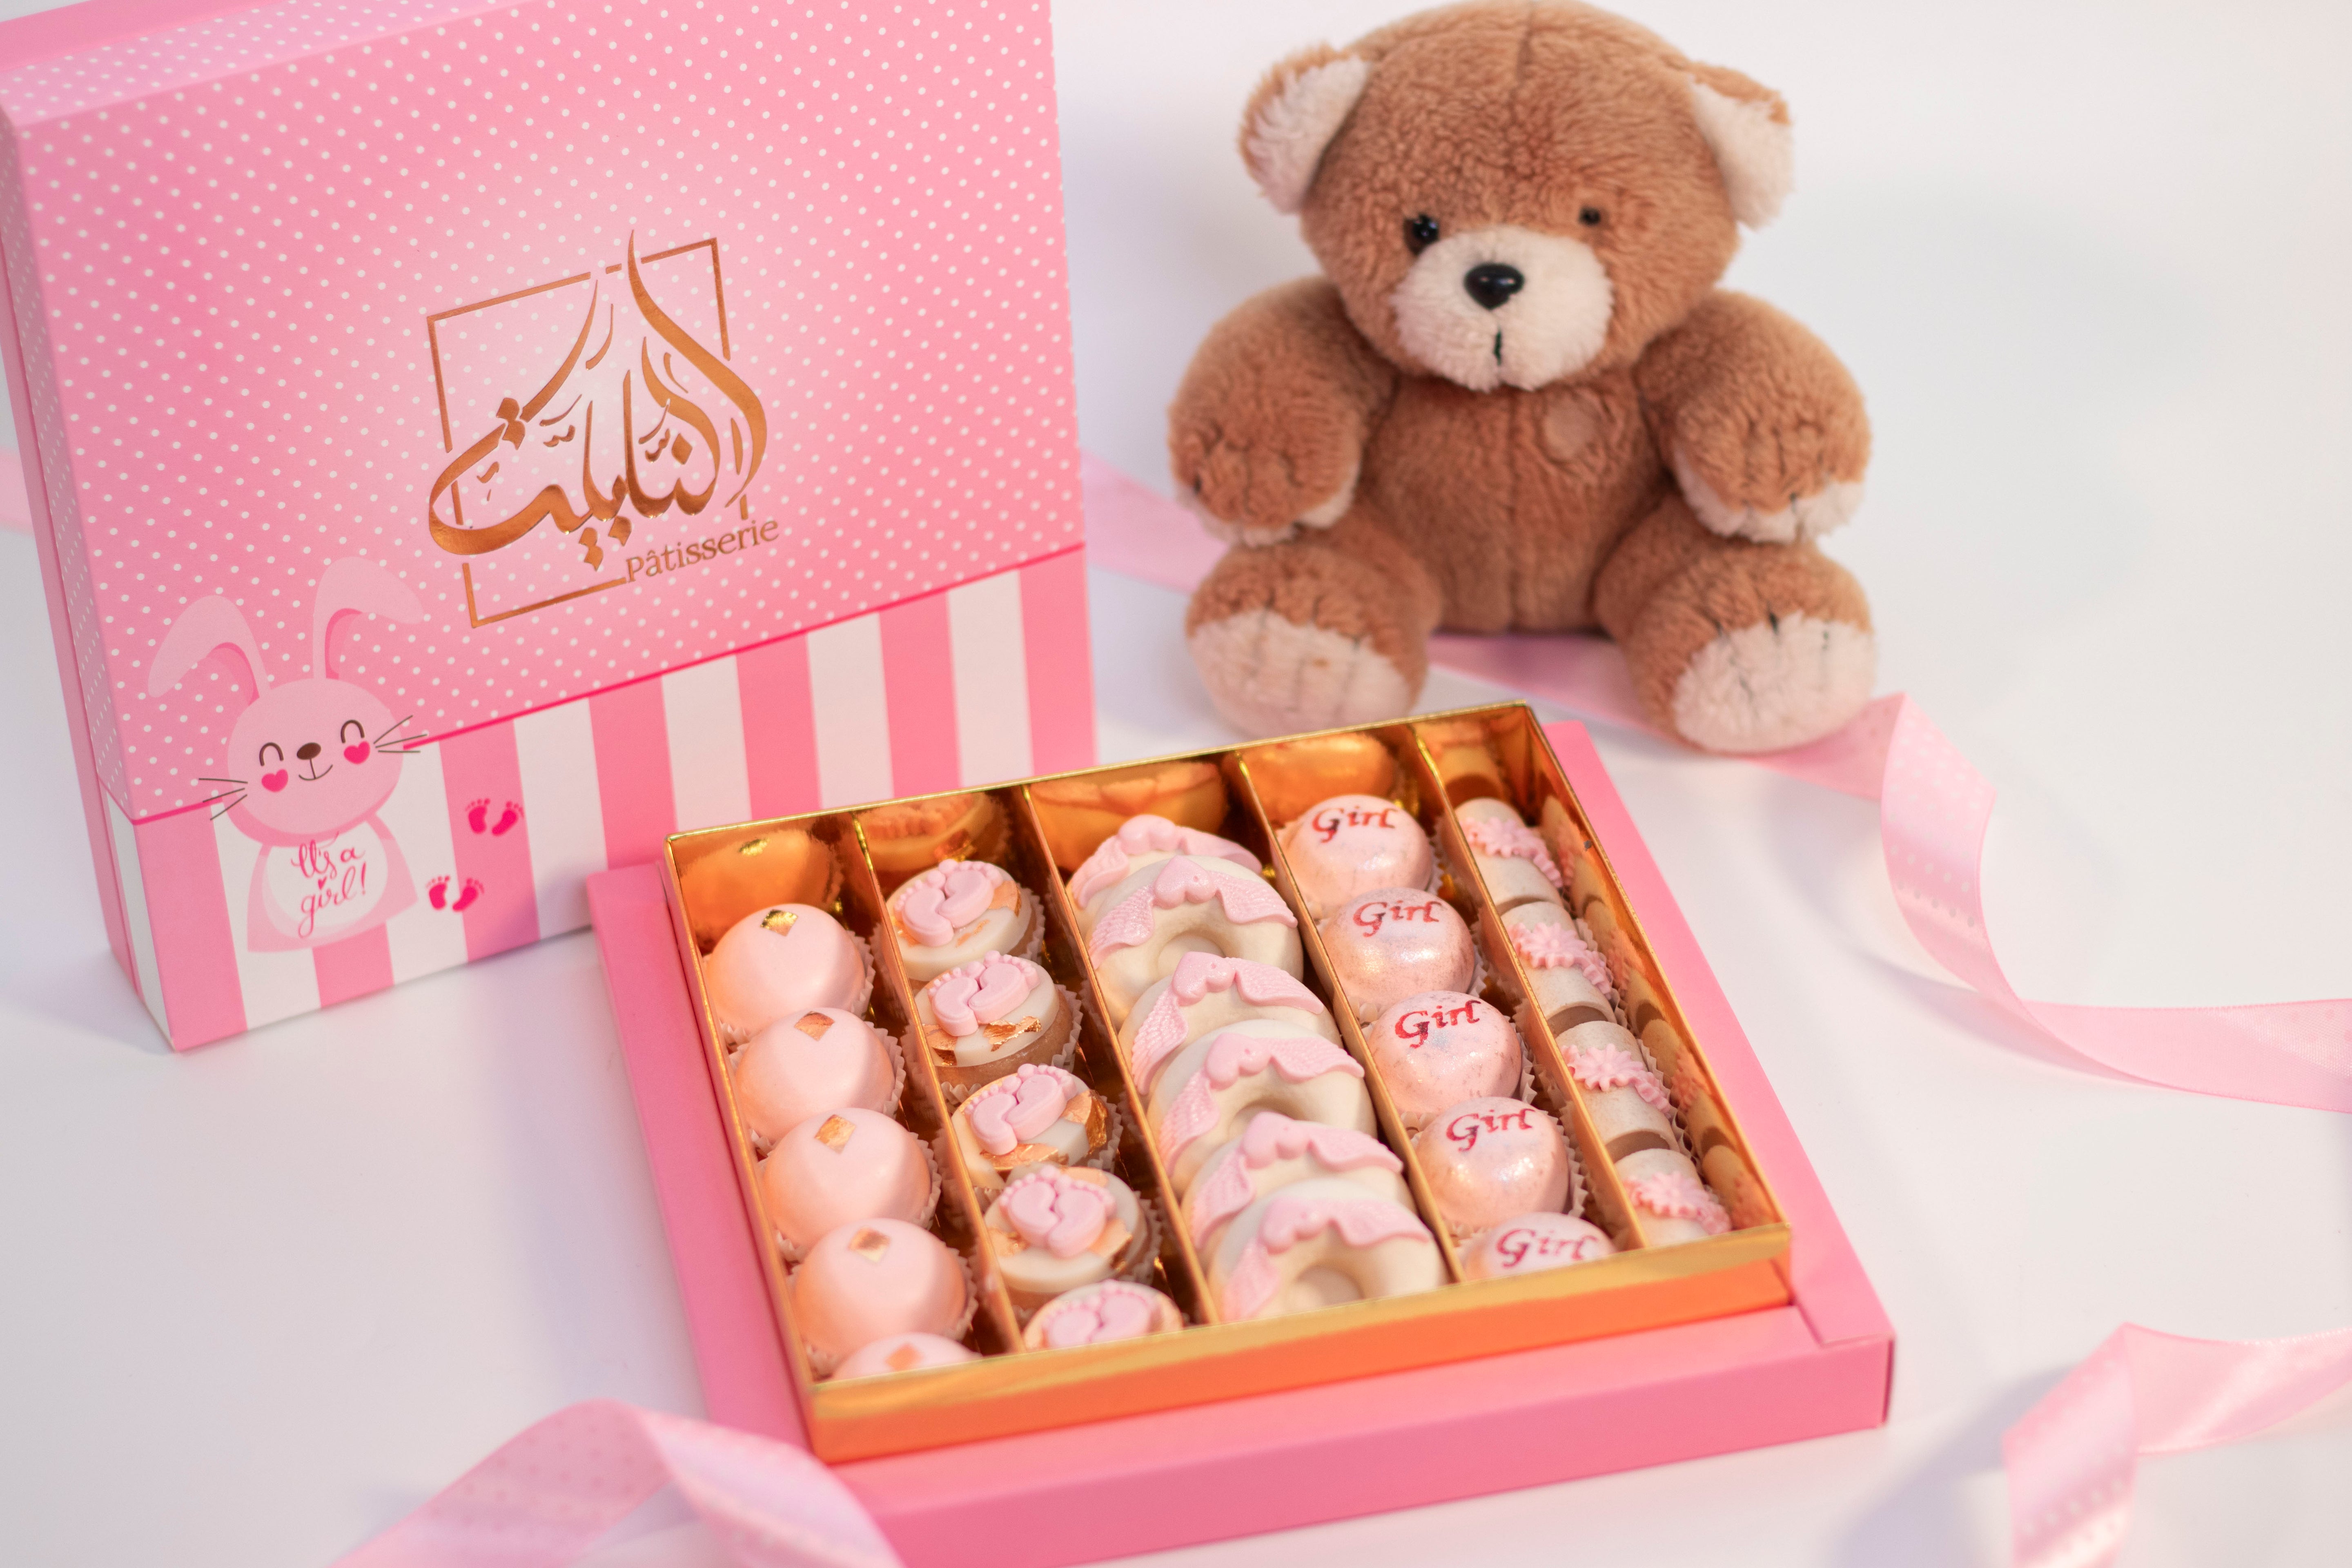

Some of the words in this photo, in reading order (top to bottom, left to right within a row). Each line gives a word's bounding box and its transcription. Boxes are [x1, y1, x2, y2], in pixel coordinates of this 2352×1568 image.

[626, 520, 779, 583] Pâtisserie
[1312, 806, 1398, 843] Girl
[291, 831, 338, 880] It's
[340, 847, 366, 863] a
[298, 861, 366, 938] girl!
[1352, 900, 1442, 938] Girl
[1394, 1000, 1481, 1049] Girl
[1446, 1108, 1537, 1152] Girl
[1496, 1228, 1599, 1268] Girl
